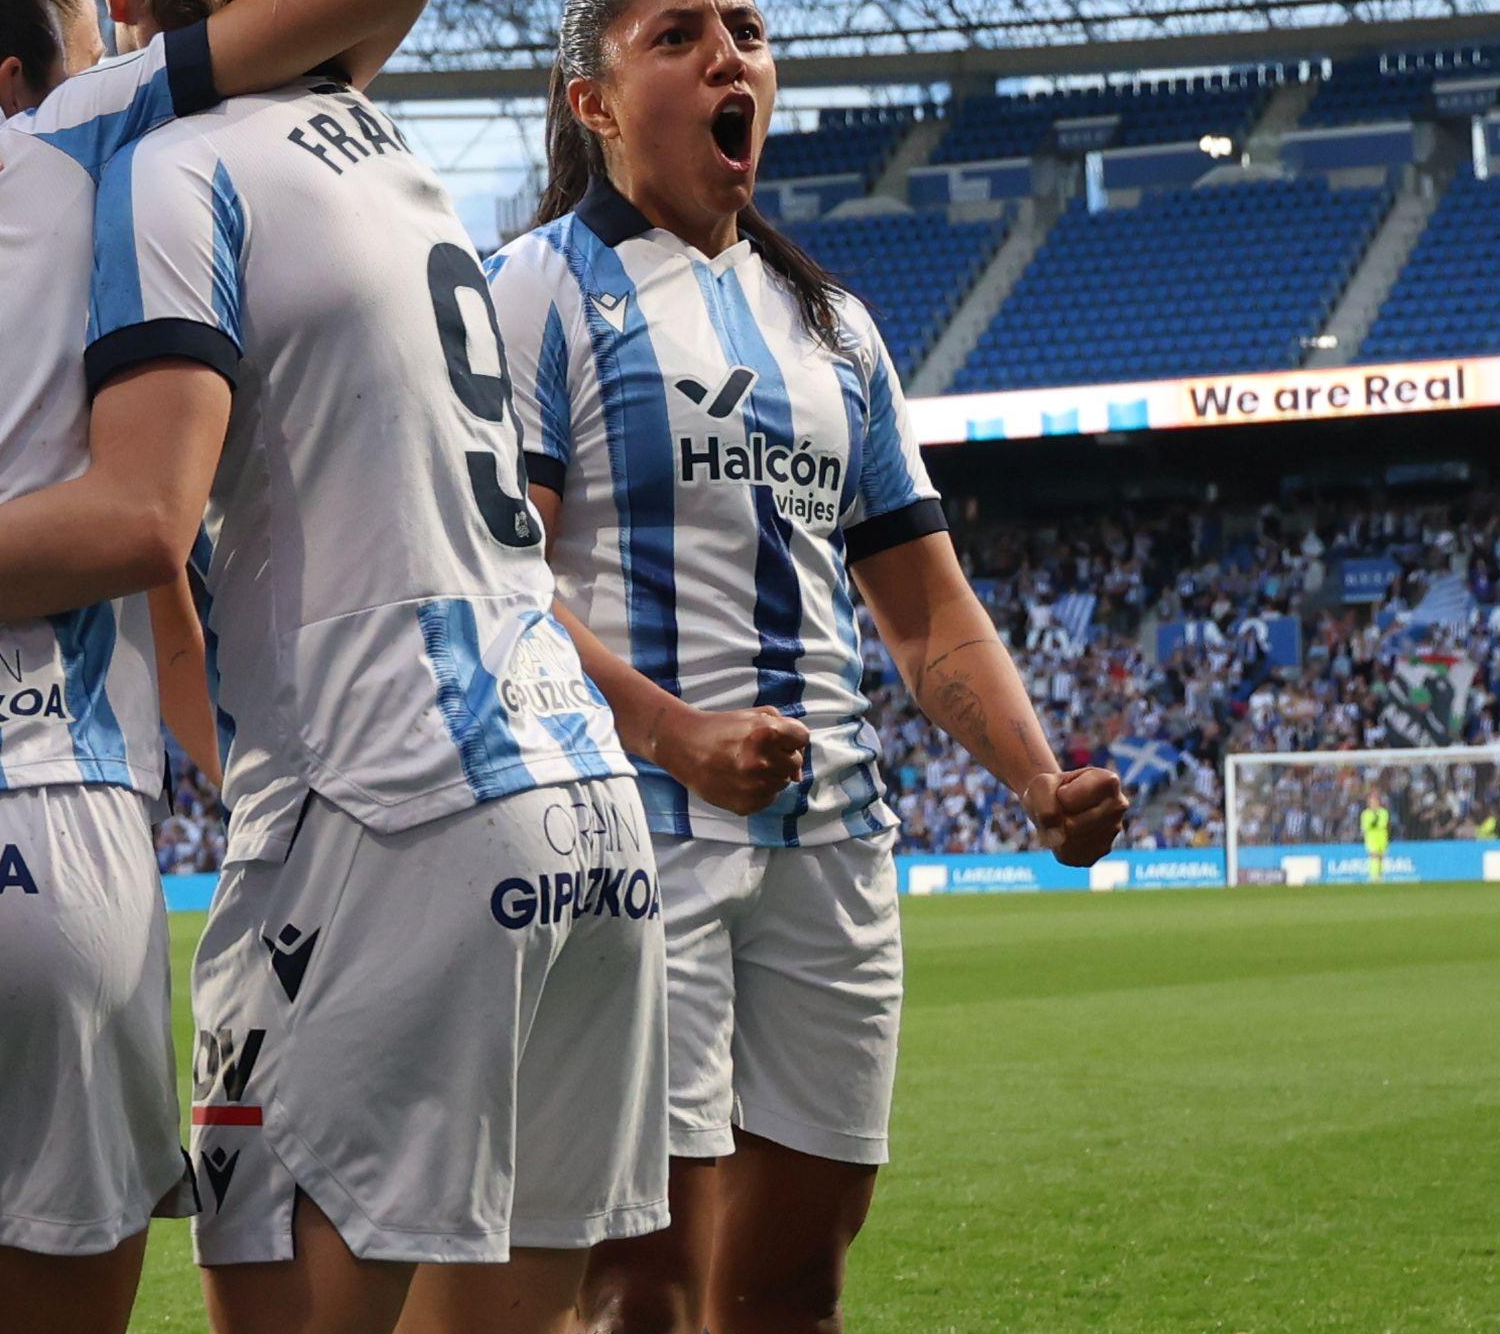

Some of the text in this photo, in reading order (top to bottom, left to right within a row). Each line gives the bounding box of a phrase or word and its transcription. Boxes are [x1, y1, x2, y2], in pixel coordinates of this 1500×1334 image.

[287, 105, 412, 175] FRA
[427, 242, 543, 547] 9
[1190, 366, 1464, 416] We are Real
[680, 436, 841, 491] Halcón
[775, 489, 834, 524] viajes
[952, 866, 1037, 885] LARZABAL
[1136, 861, 1221, 880] LARZABAL
